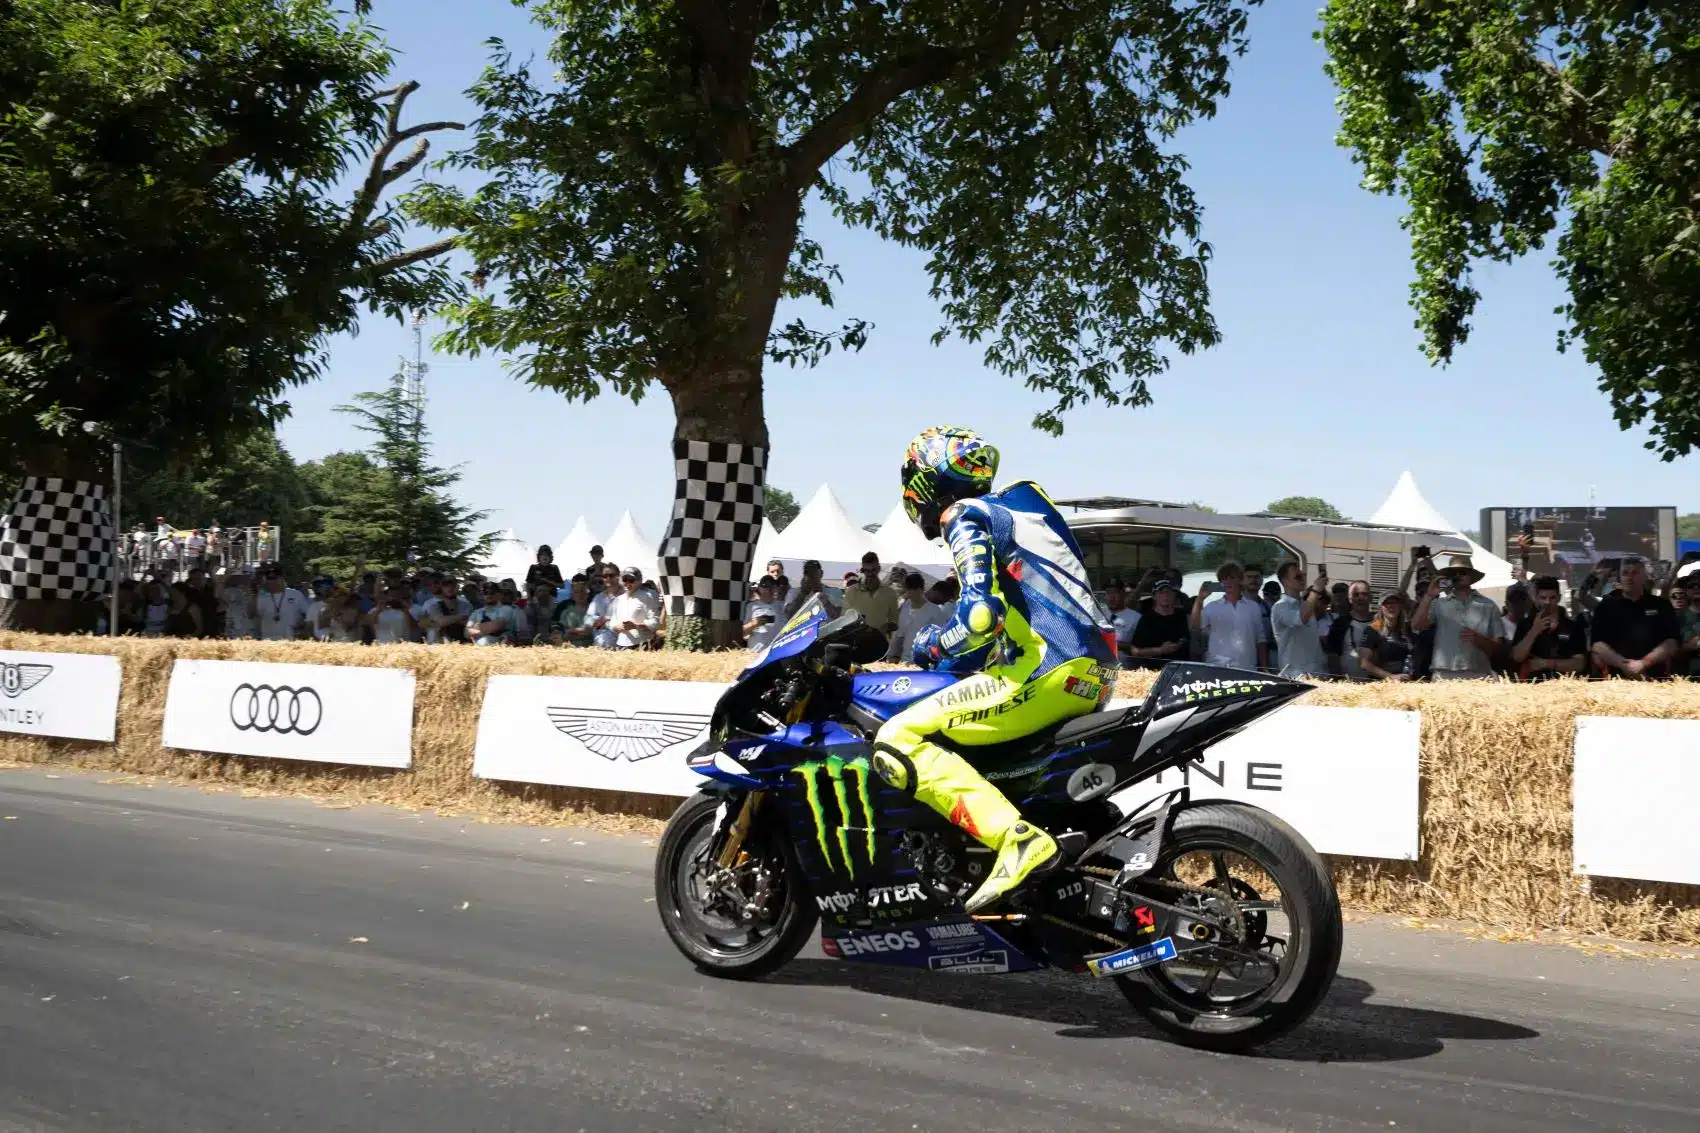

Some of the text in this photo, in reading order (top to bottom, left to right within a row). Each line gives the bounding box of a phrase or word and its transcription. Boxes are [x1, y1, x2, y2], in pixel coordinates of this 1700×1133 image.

[1087, 663, 1118, 681] DAIN
[935, 676, 1007, 707] YAMAHA
[1172, 679, 1276, 696] MONSTER
[1185, 685, 1264, 702] ENERGY
[947, 685, 1037, 729] DAINESE
[0, 708, 44, 725] NTLEY
[589, 719, 660, 736] ASTON MARTIN
[1082, 769, 1103, 791] 46
[1156, 760, 1282, 791] INE
[836, 906, 913, 924] EERGY
[925, 923, 979, 940] YAMALUBE
[837, 930, 921, 956] ENEOS
[1113, 946, 1165, 969] MICHELIN
